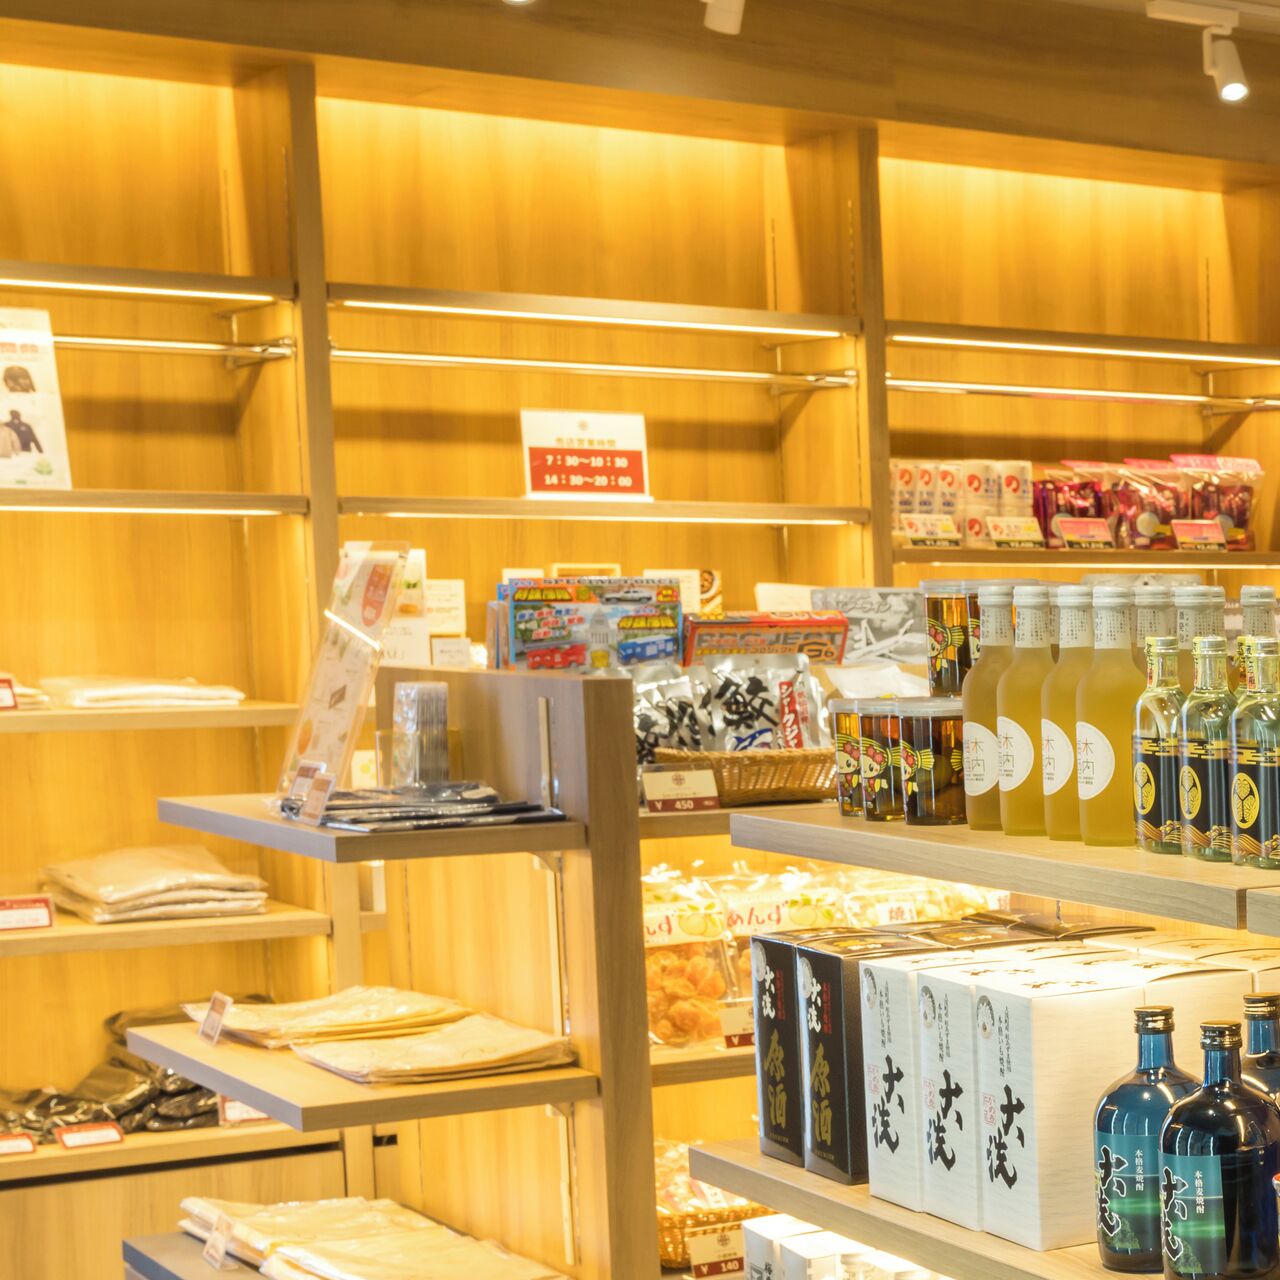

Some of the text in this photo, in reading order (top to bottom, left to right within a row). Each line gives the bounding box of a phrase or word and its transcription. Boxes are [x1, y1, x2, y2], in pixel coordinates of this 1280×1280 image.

[764, 1028, 787, 1130] 原酒
[810, 1042, 833, 1147] 原酒
[872, 1054, 905, 1154] 大洗
[926, 1070, 964, 1171] 大洗
[986, 1084, 1026, 1190] 大洗
[1135, 1149, 1145, 1192] 本格麦焼酎
[1194, 1170, 1205, 1214] 本格麦焼酎
